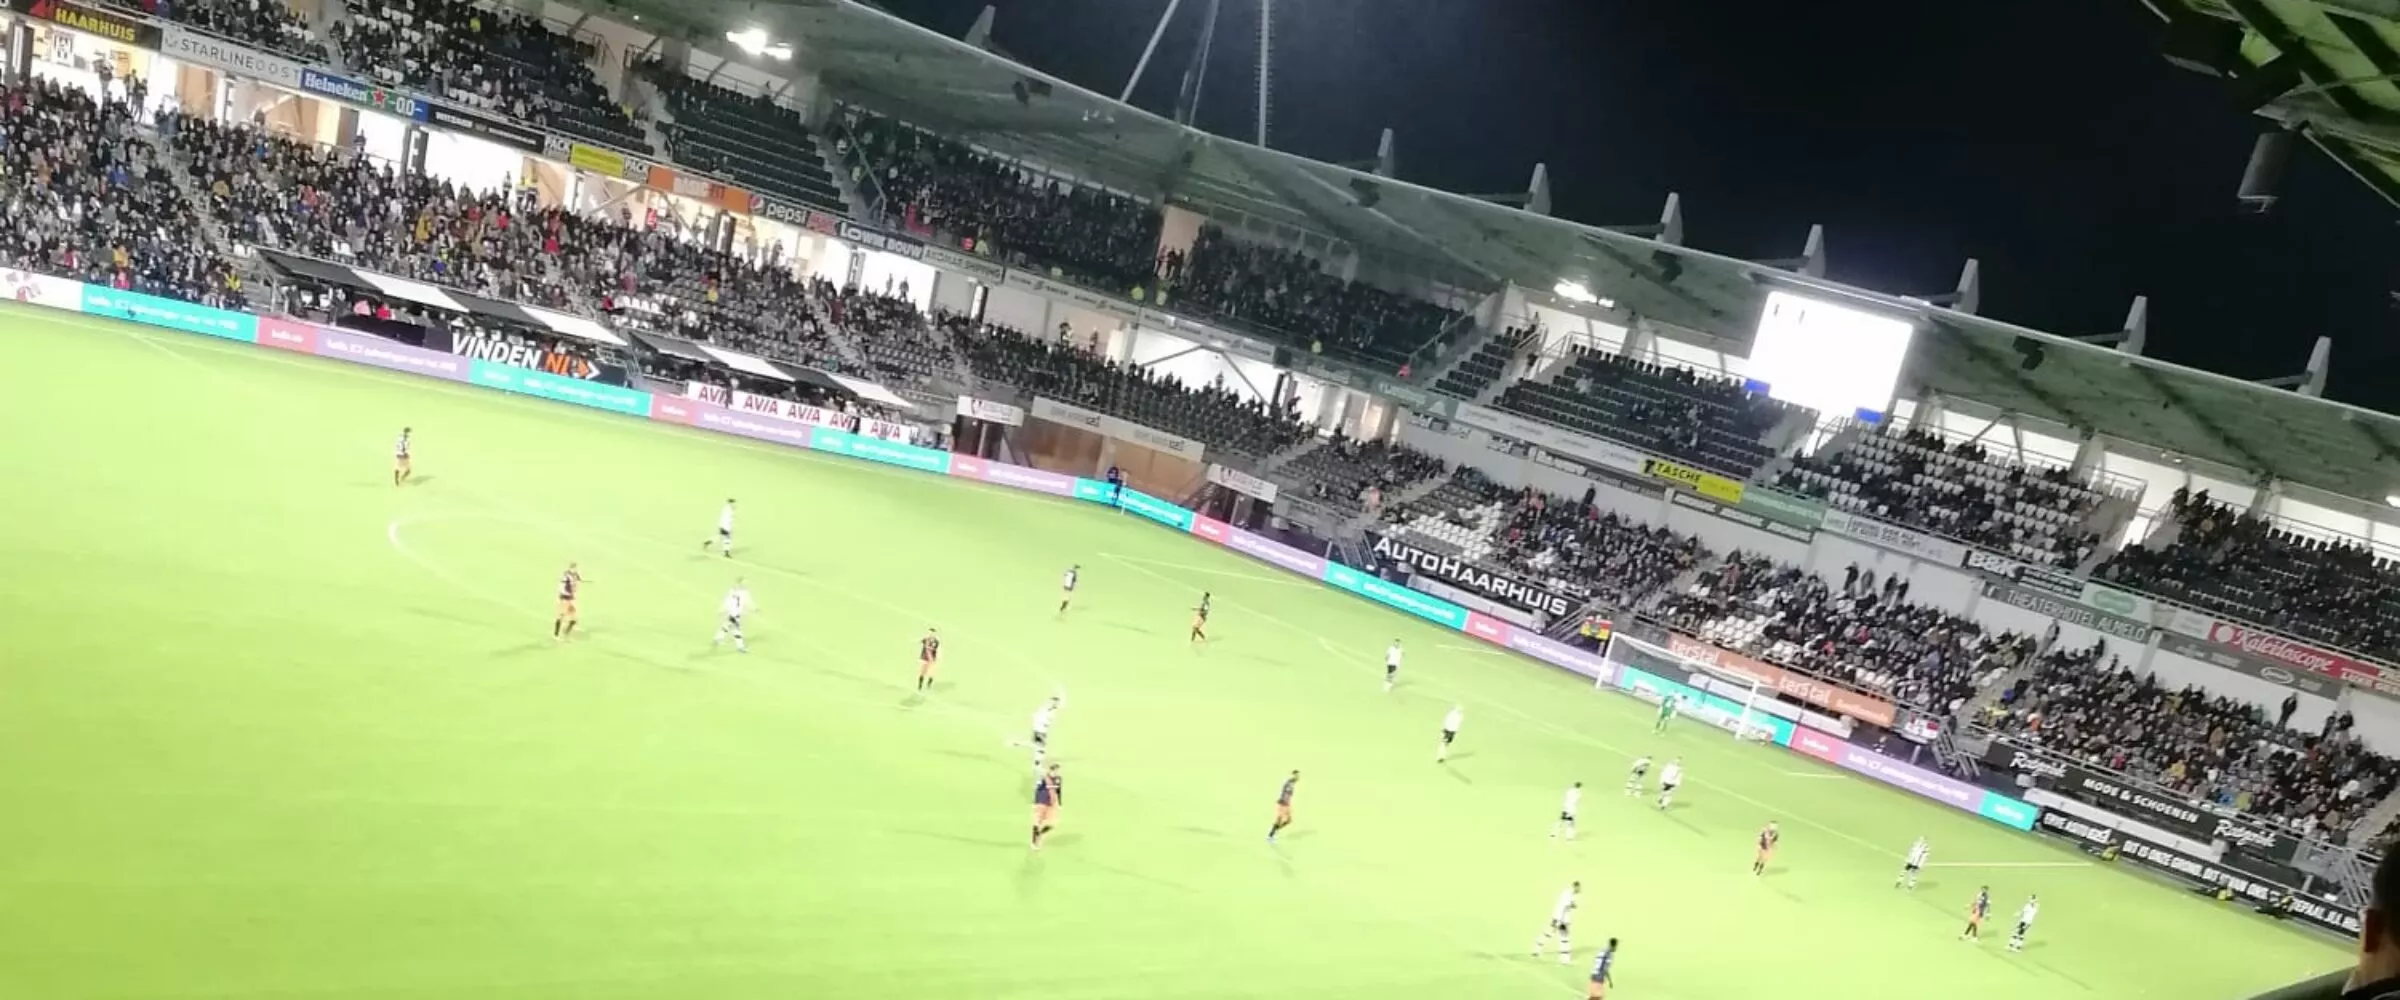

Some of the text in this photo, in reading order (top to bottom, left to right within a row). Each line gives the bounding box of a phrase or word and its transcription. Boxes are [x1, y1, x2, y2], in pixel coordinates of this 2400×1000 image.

[56, 8, 136, 41] HAARHUIS
[304, 72, 367, 102] Heineken
[766, 203, 807, 224] pepsi
[744, 395, 779, 416] AVIA
[787, 403, 821, 423] AVIA
[2097, 616, 2147, 642] ALMELO
[2234, 629, 2335, 672] Kaleidoscope
[2083, 778, 2120, 797] MODE
[2133, 794, 2199, 824] SCHOENEN
